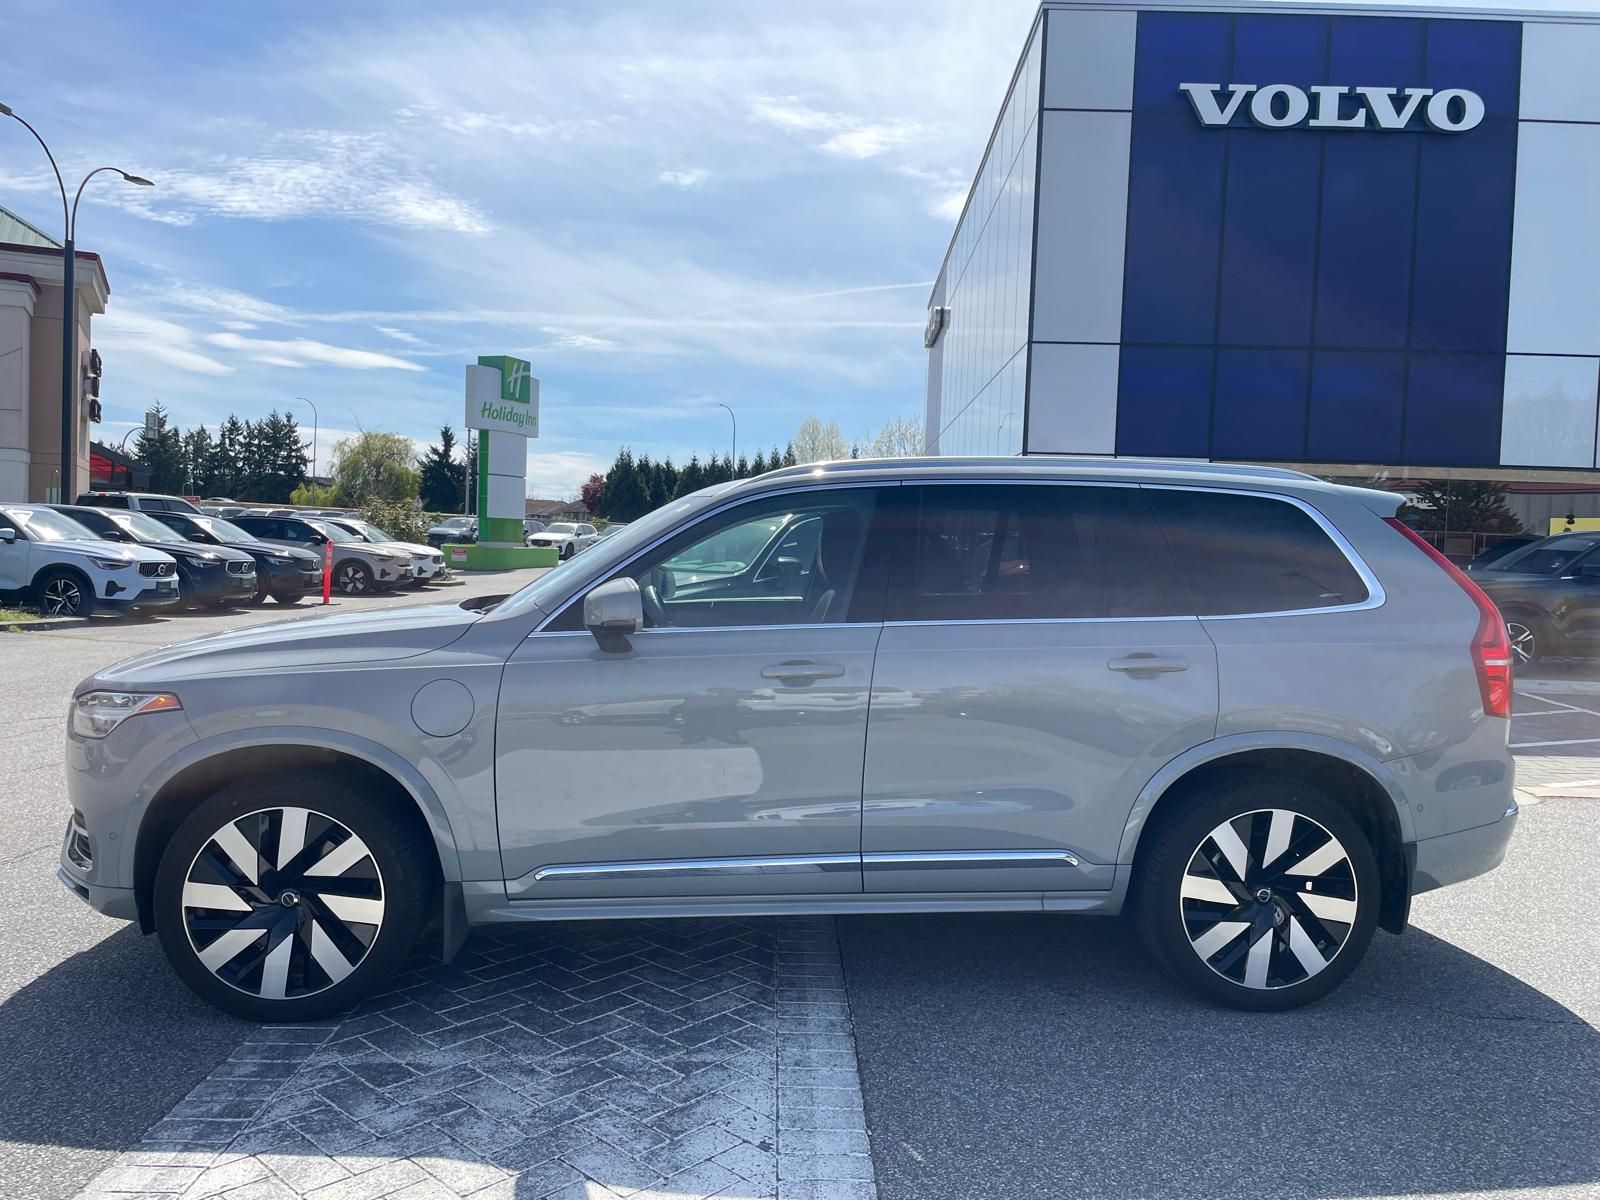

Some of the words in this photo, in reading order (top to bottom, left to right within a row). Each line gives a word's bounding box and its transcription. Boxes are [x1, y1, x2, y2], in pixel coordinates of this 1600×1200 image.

[1179, 83, 1485, 132] VOLVO
[480, 401, 526, 428] Holiday
[525, 409, 537, 427] Inn
